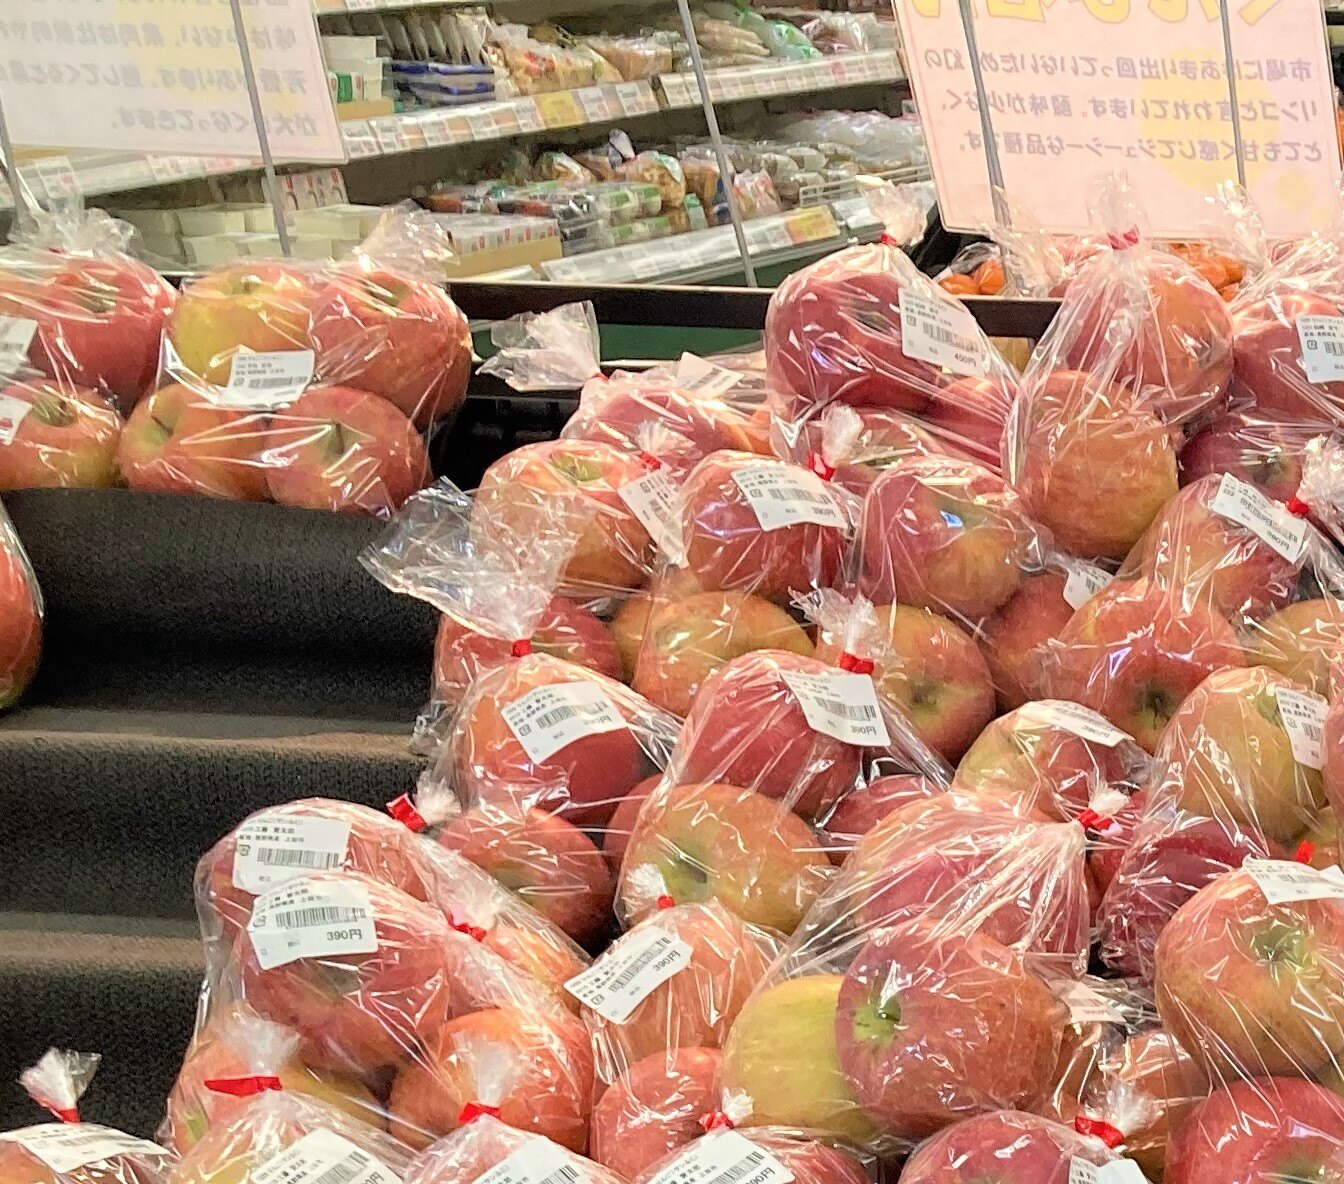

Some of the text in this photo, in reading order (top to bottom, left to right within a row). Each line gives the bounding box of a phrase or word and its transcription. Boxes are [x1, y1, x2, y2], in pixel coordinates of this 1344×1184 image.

[953, 351, 977, 367] 450円
[325, 927, 363, 944] 390円
[651, 948, 682, 975] 390円
